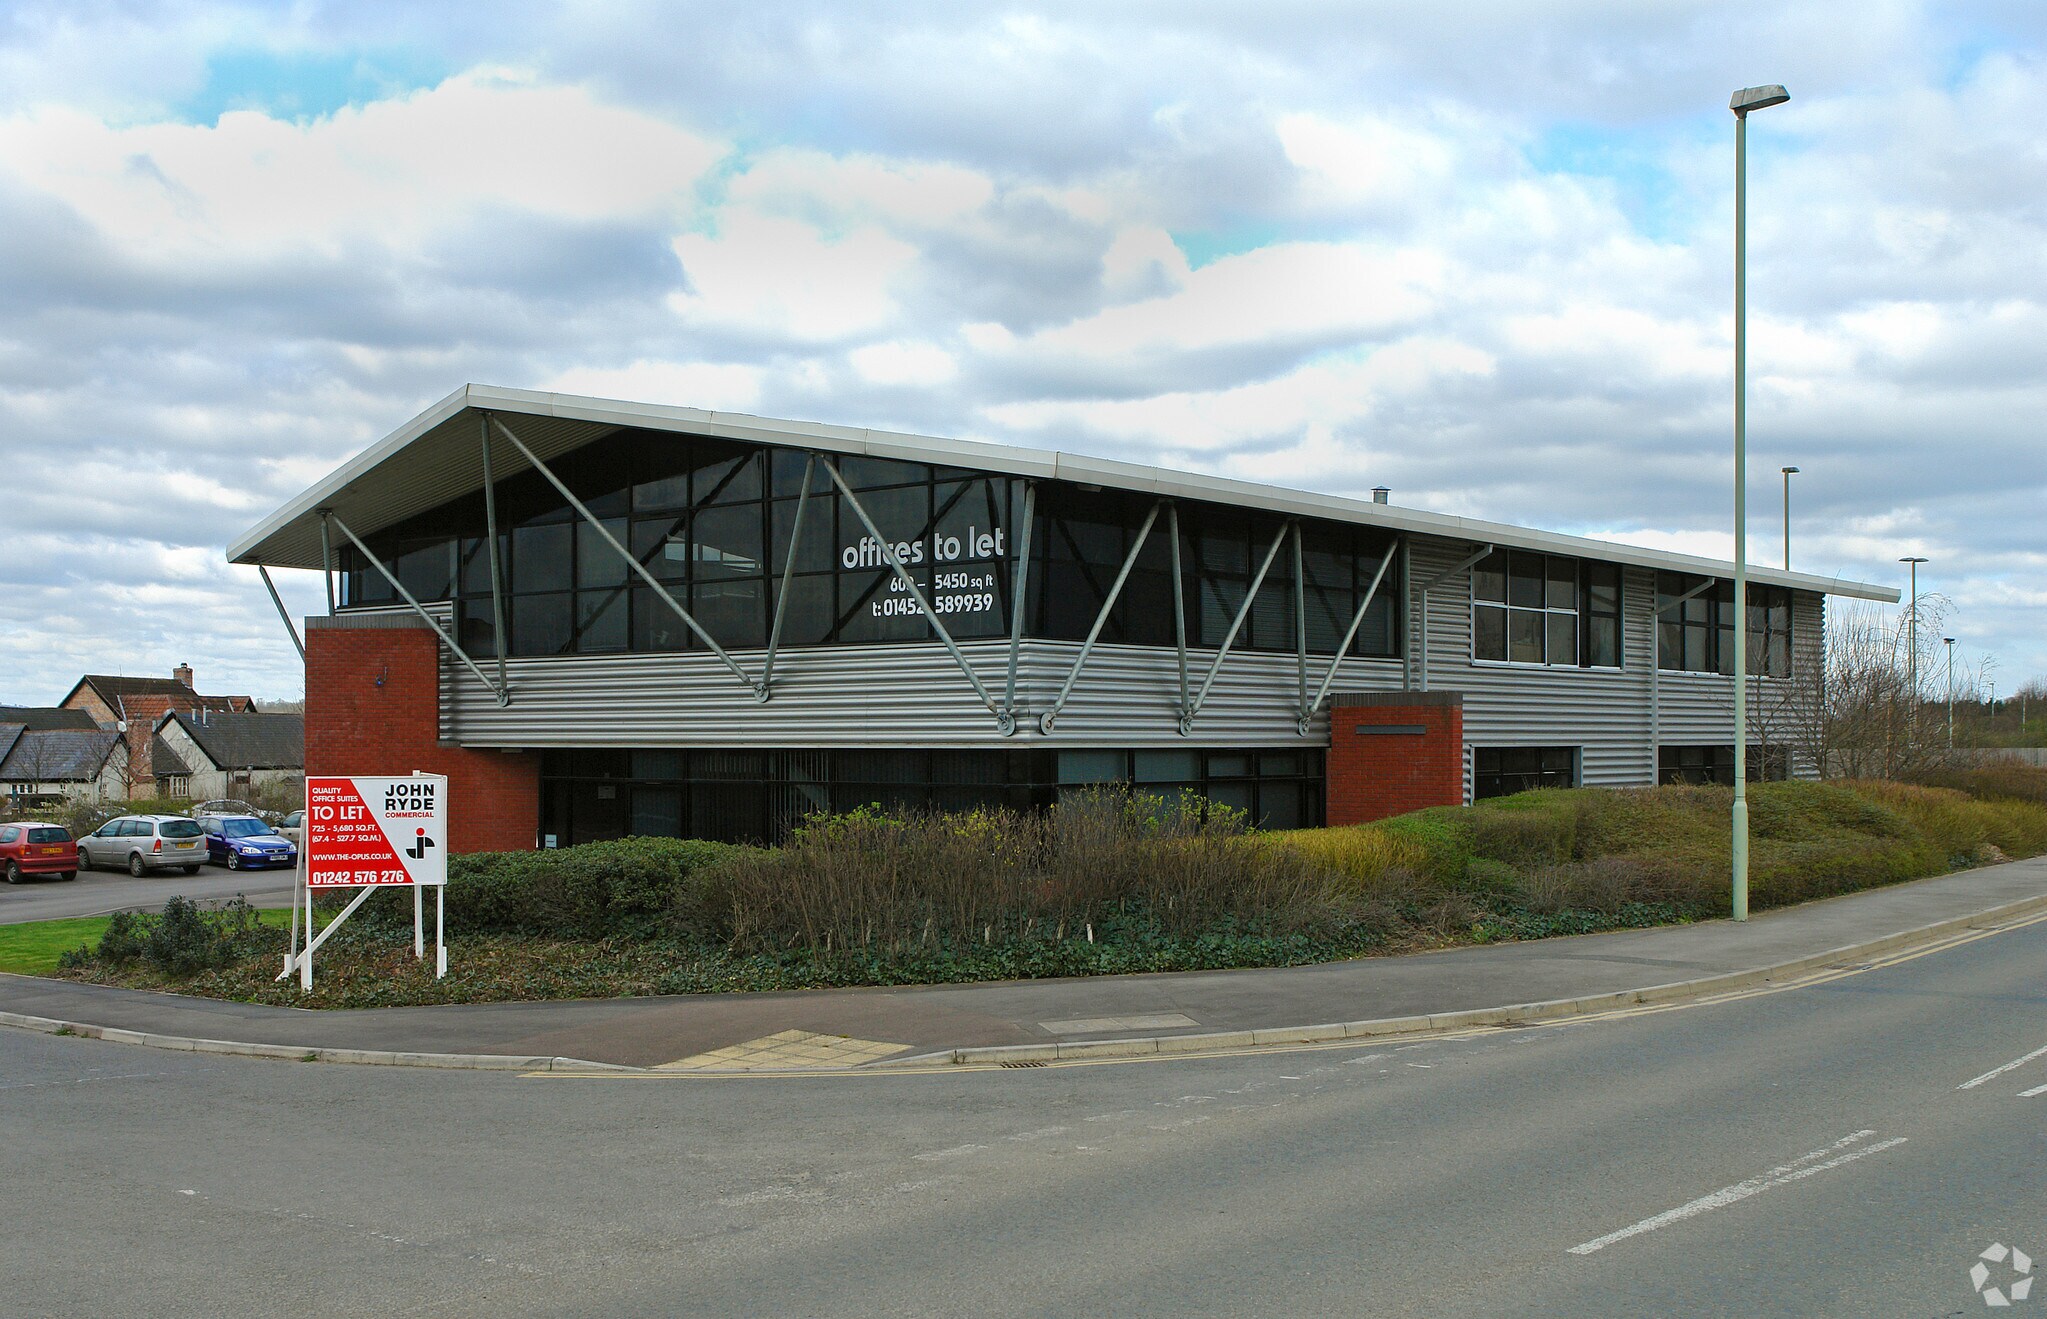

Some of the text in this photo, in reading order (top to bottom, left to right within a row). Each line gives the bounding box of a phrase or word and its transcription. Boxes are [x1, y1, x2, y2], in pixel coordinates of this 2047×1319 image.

[934, 533, 961, 560] to
[969, 526, 1004, 558] let
[890, 576, 914, 592] 60
[934, 572, 968, 590] 5450
[970, 577, 983, 590] sq
[985, 573, 993, 587] ft
[935, 593, 993, 614] 589939
[384, 784, 435, 797] JOHN
[312, 795, 359, 803] OFFICE SUITES
[384, 798, 435, 811] RYDE
[311, 805, 365, 820] TO LET
[384, 811, 435, 819] COMMERCIAL
[312, 824, 326, 832] 725
[355, 824, 378, 832] SQ.FT.
[312, 835, 330, 843] (67.4
[312, 852, 393, 861] WWW.THE-OPUS.CO.UK
[312, 870, 405, 884] 01242 576 276
